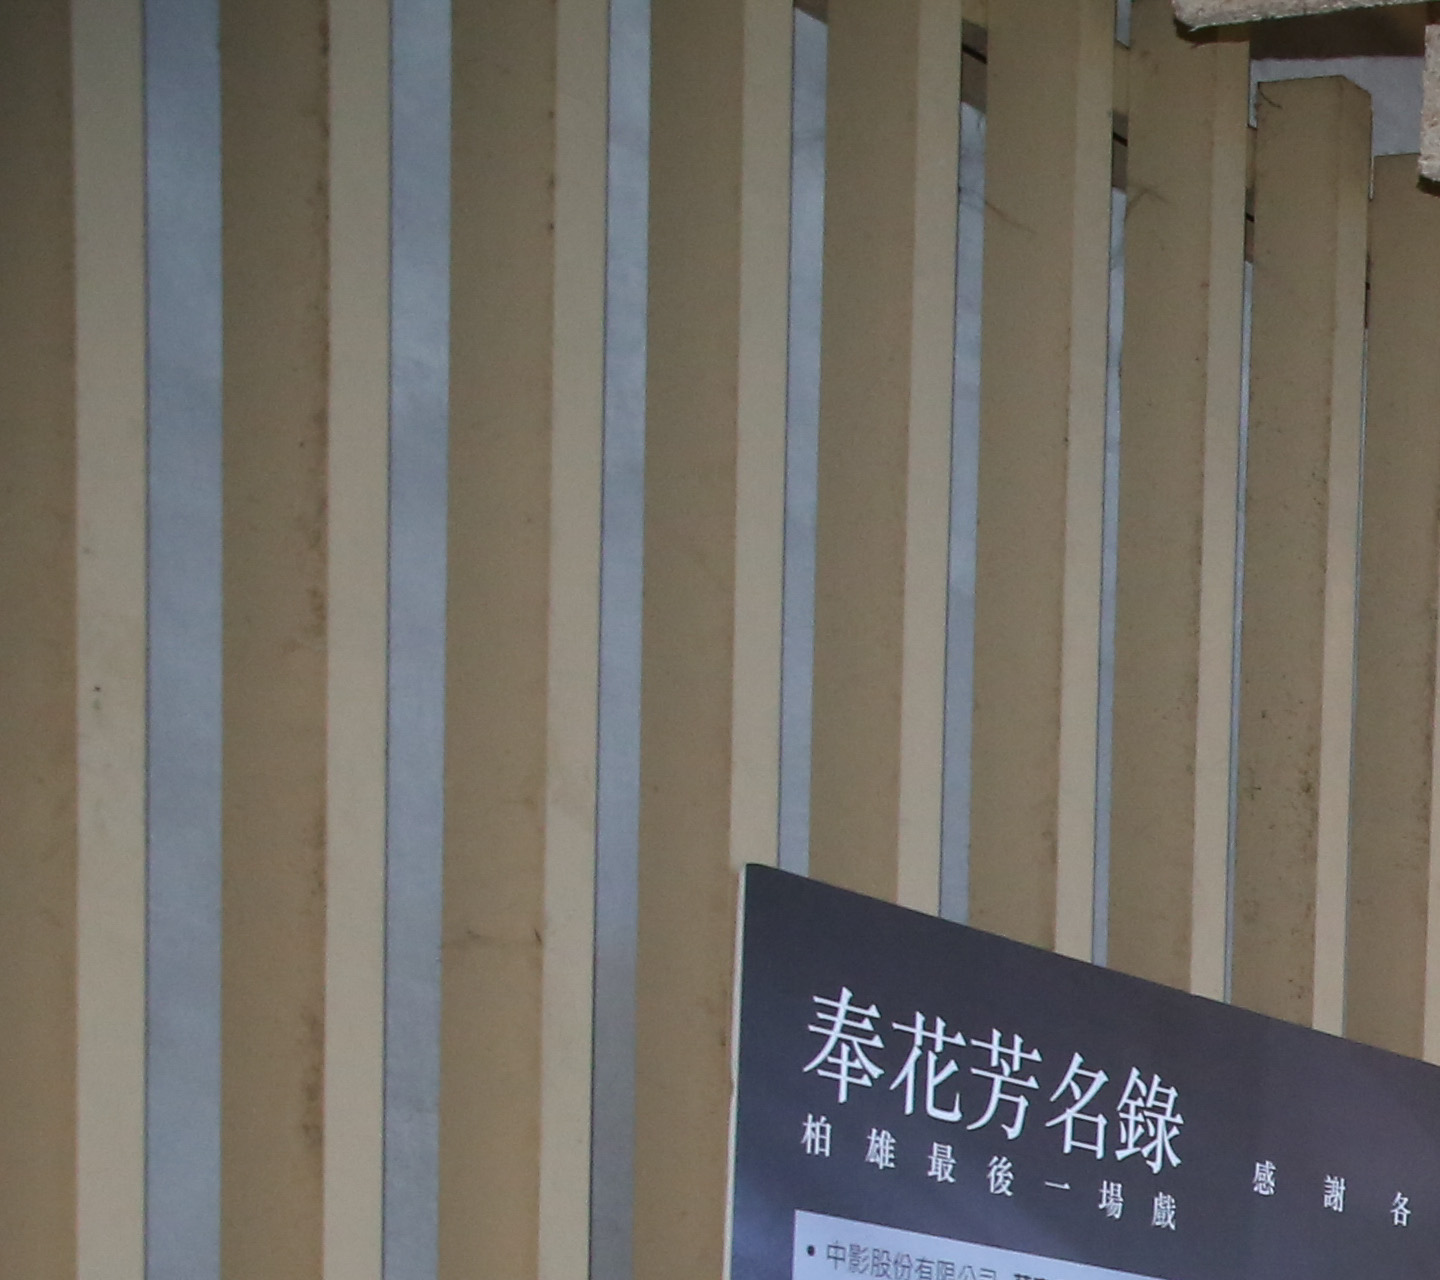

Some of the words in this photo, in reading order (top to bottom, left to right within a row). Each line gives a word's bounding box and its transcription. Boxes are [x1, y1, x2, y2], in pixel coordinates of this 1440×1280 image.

[803, 986, 1184, 1174] 奉花芳名錄
[801, 1114, 1176, 1231] 柏雄最後一場戲
